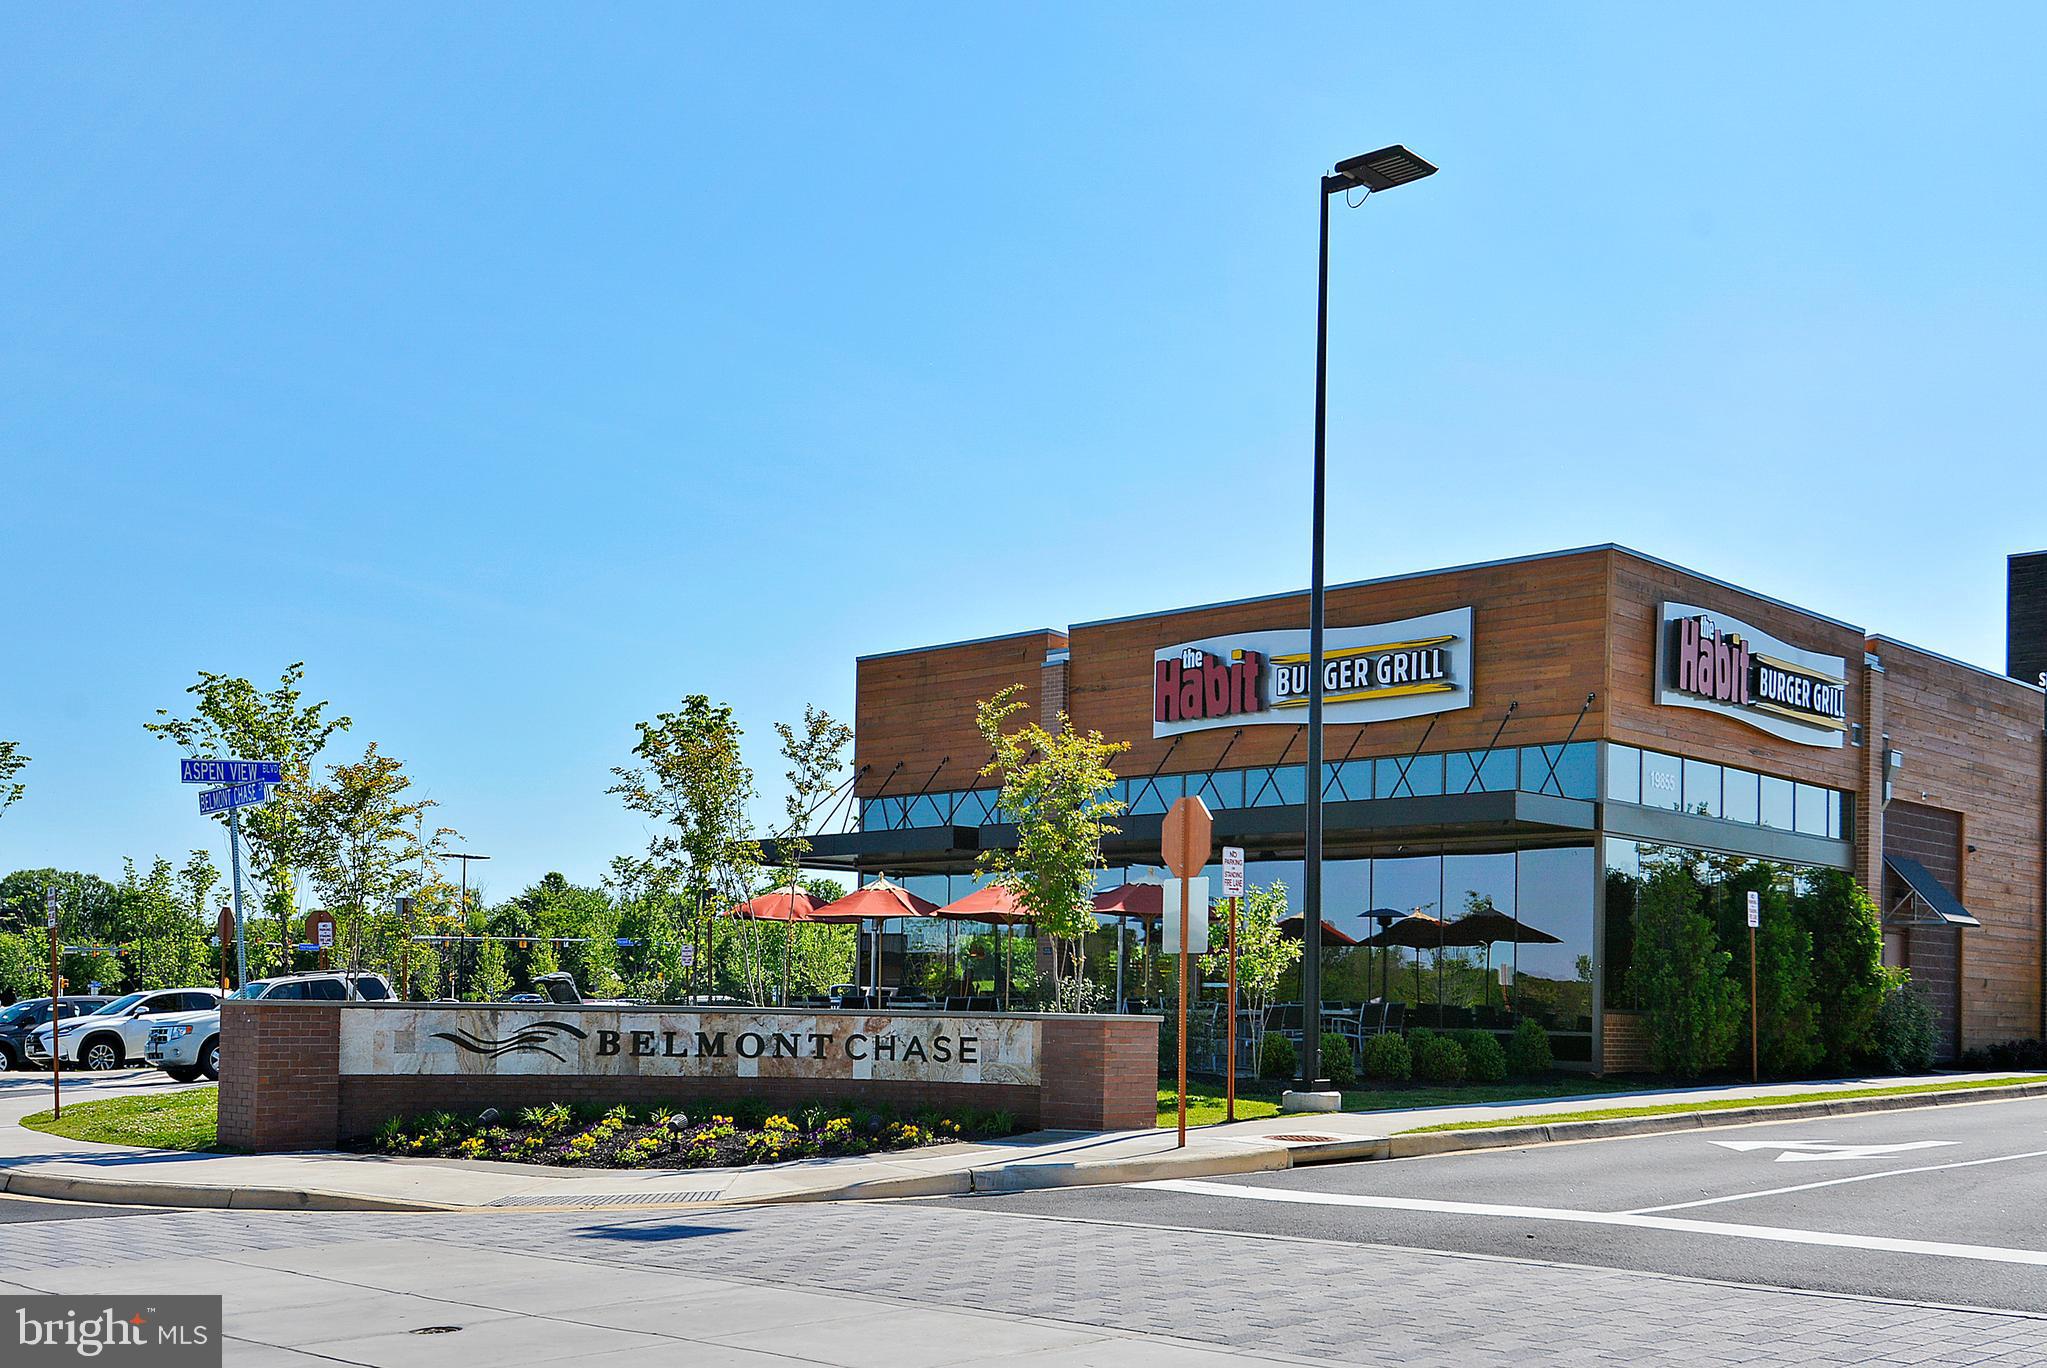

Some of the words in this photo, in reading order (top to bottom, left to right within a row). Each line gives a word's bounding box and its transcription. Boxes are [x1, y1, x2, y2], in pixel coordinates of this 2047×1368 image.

[1700, 615, 1715, 640] the
[1182, 649, 1203, 670] the
[1680, 618, 1750, 705] Habit
[1759, 667, 1811, 709] BURGER
[1813, 683, 1846, 718] GRILL
[1155, 649, 1261, 722] Habit
[1277, 658, 1369, 696] BUGER
[1376, 649, 1444, 685] GRILL
[184, 762, 225, 780] ASPEN
[230, 763, 258, 781] VIEW
[262, 764, 279, 774] BLVD
[200, 789, 231, 811] BELMONT
[233, 783, 257, 805] CHASE
[596, 1030, 833, 1060] BELMONT
[844, 1035, 979, 1064] CHASE
